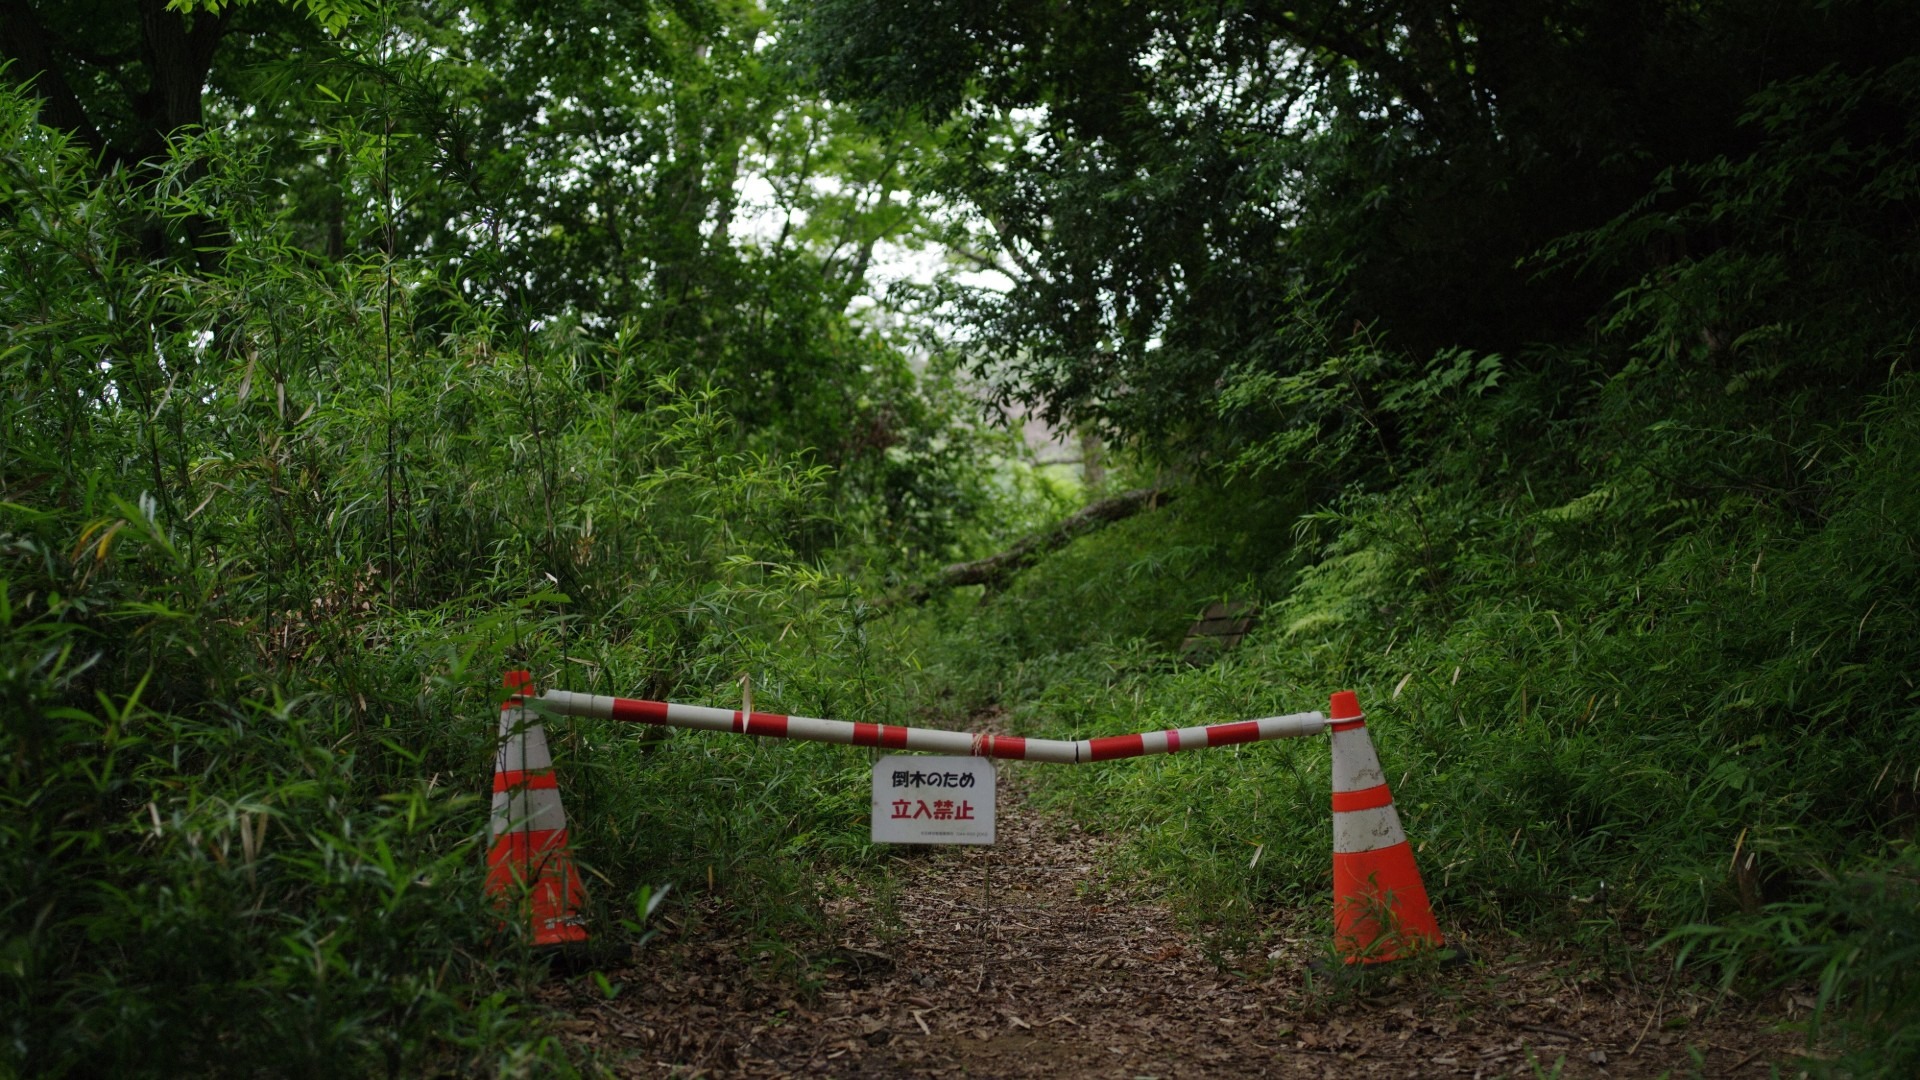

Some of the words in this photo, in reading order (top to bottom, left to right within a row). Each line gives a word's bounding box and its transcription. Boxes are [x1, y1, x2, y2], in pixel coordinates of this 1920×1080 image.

[892, 770, 975, 788] 倒木のため
[891, 799, 975, 820] 立入禁止
